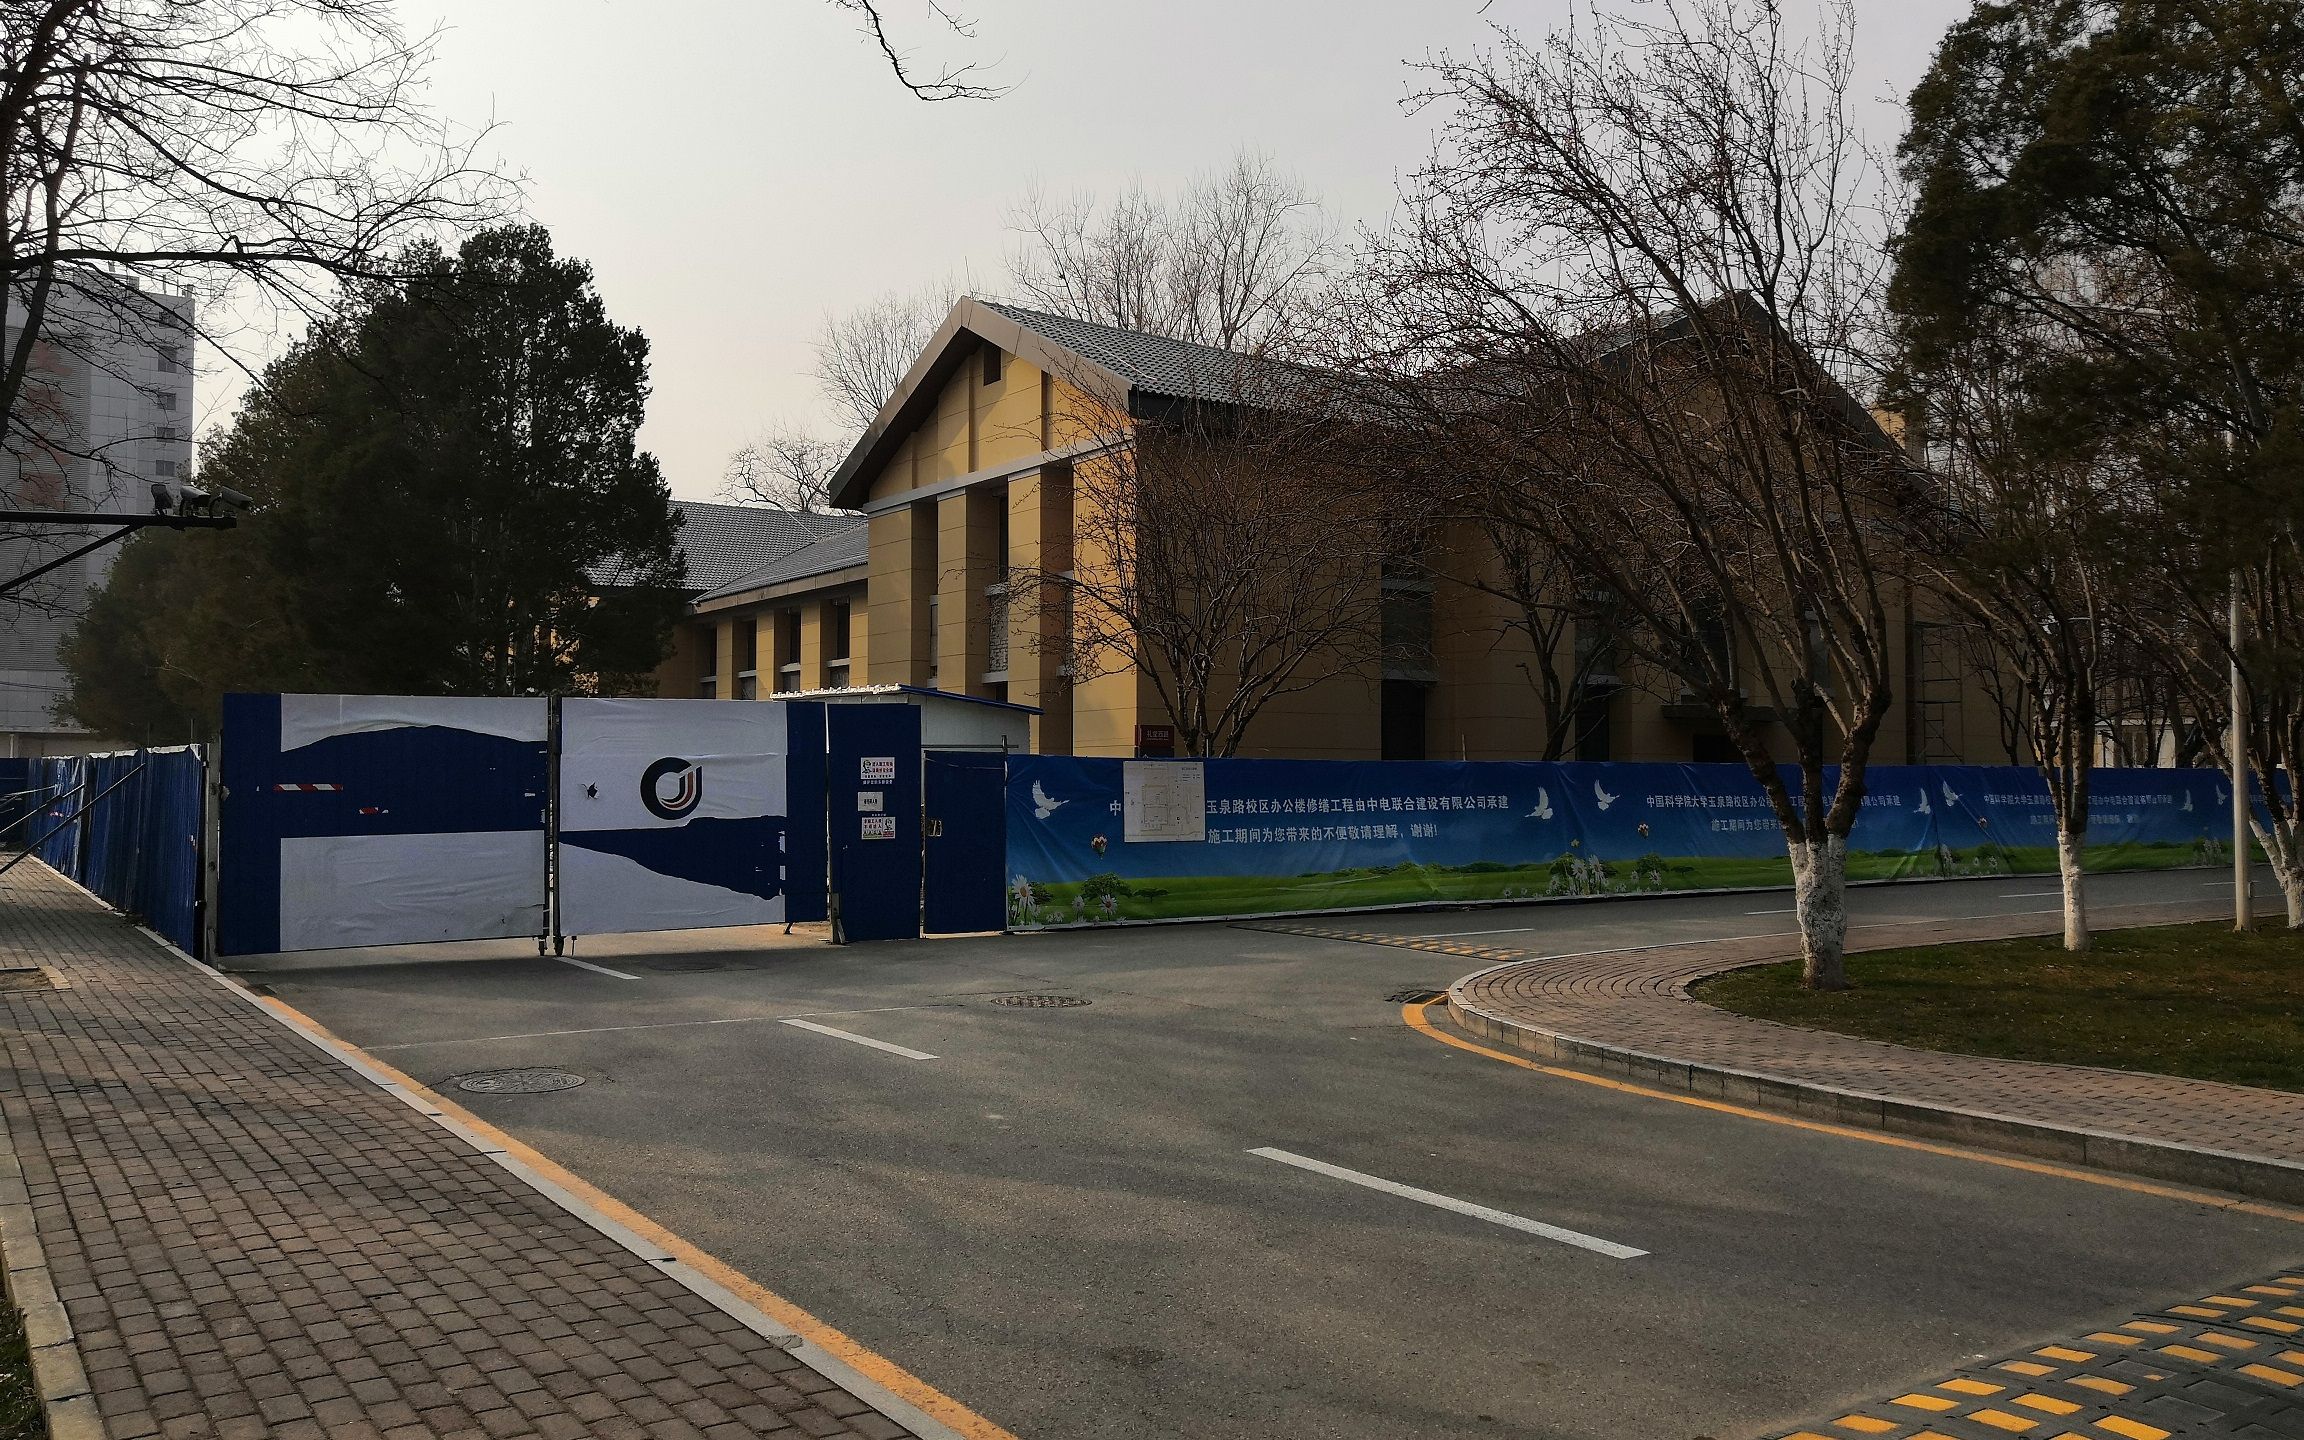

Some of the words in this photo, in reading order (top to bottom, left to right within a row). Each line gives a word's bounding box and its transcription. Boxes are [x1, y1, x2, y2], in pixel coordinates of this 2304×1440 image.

[1109, 795, 1509, 817] 中玉泉路校区办公楼修缮工程由中电联合建设有限公司承建
